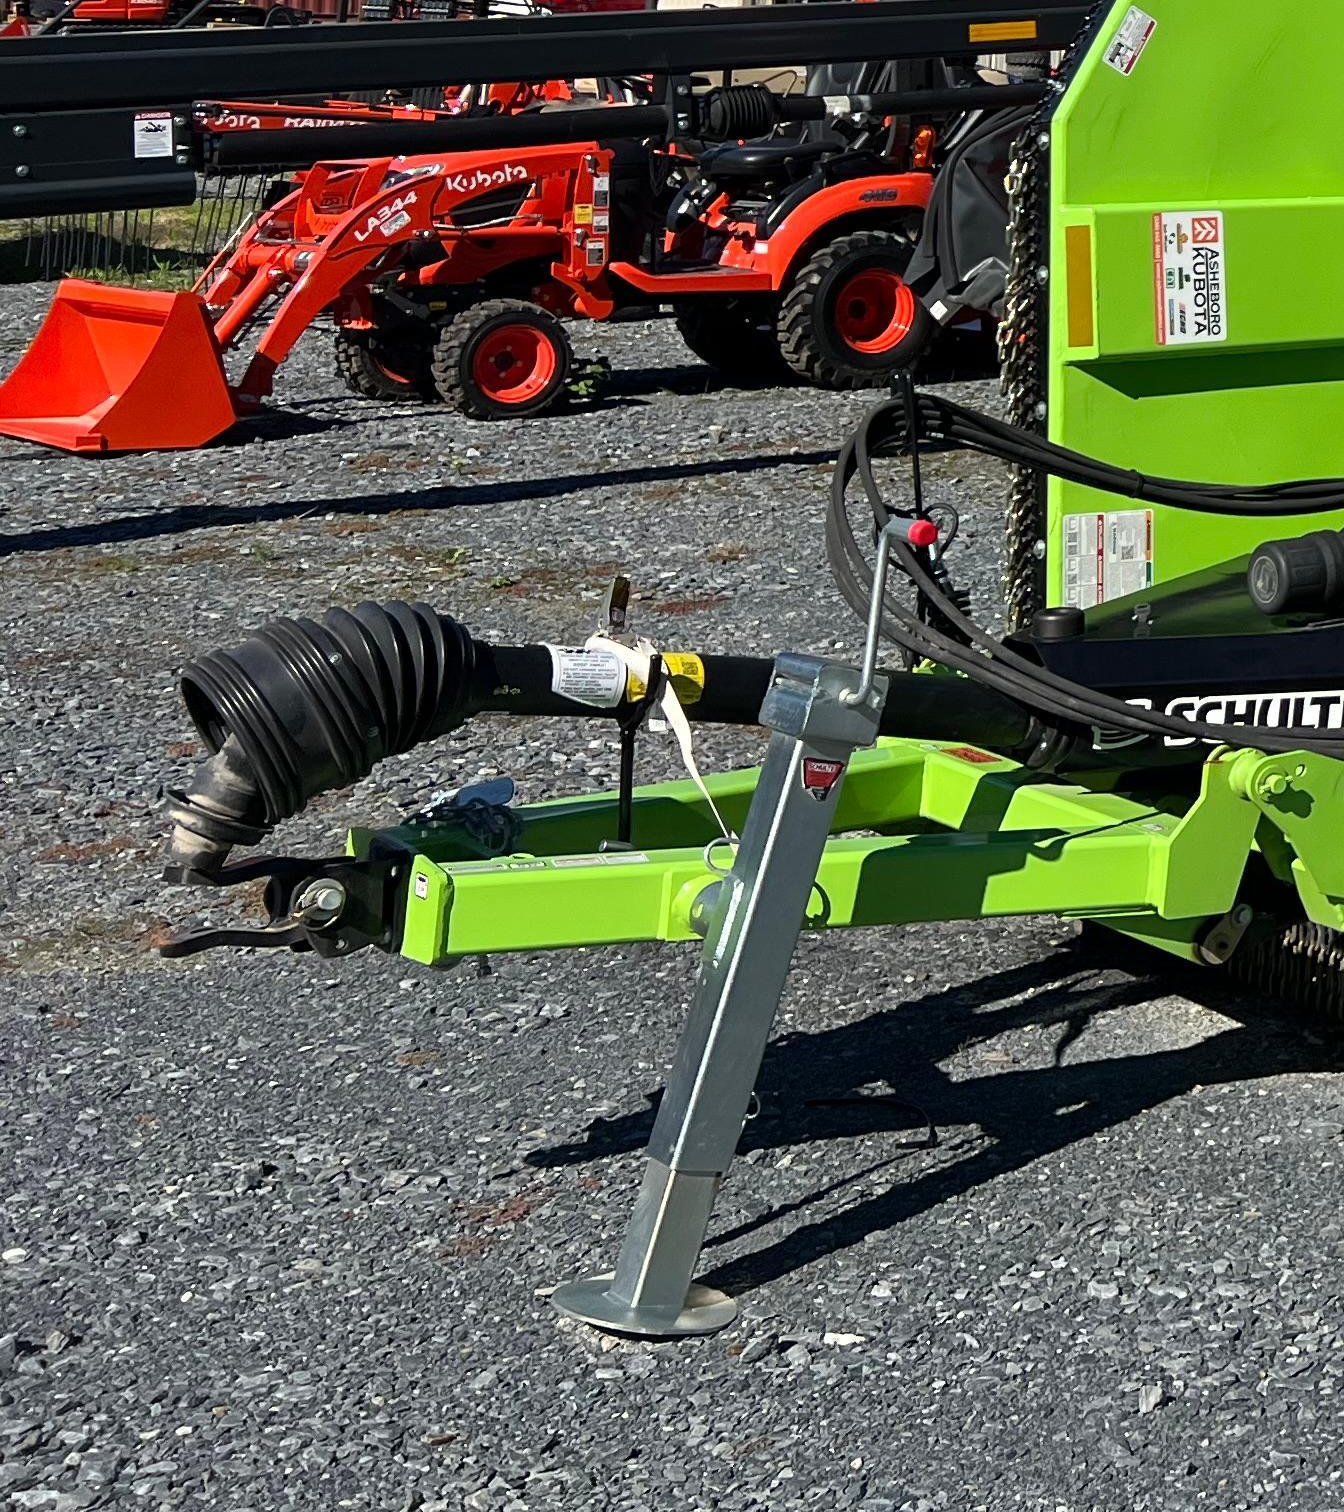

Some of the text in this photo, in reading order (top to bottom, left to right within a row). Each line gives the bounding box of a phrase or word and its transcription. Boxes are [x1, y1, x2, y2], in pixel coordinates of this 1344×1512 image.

[446, 162, 528, 193] Kubota
[354, 190, 418, 241] LA344
[1192, 247, 1207, 336] KUBOTA
[1206, 247, 1222, 336] ASHEBORO
